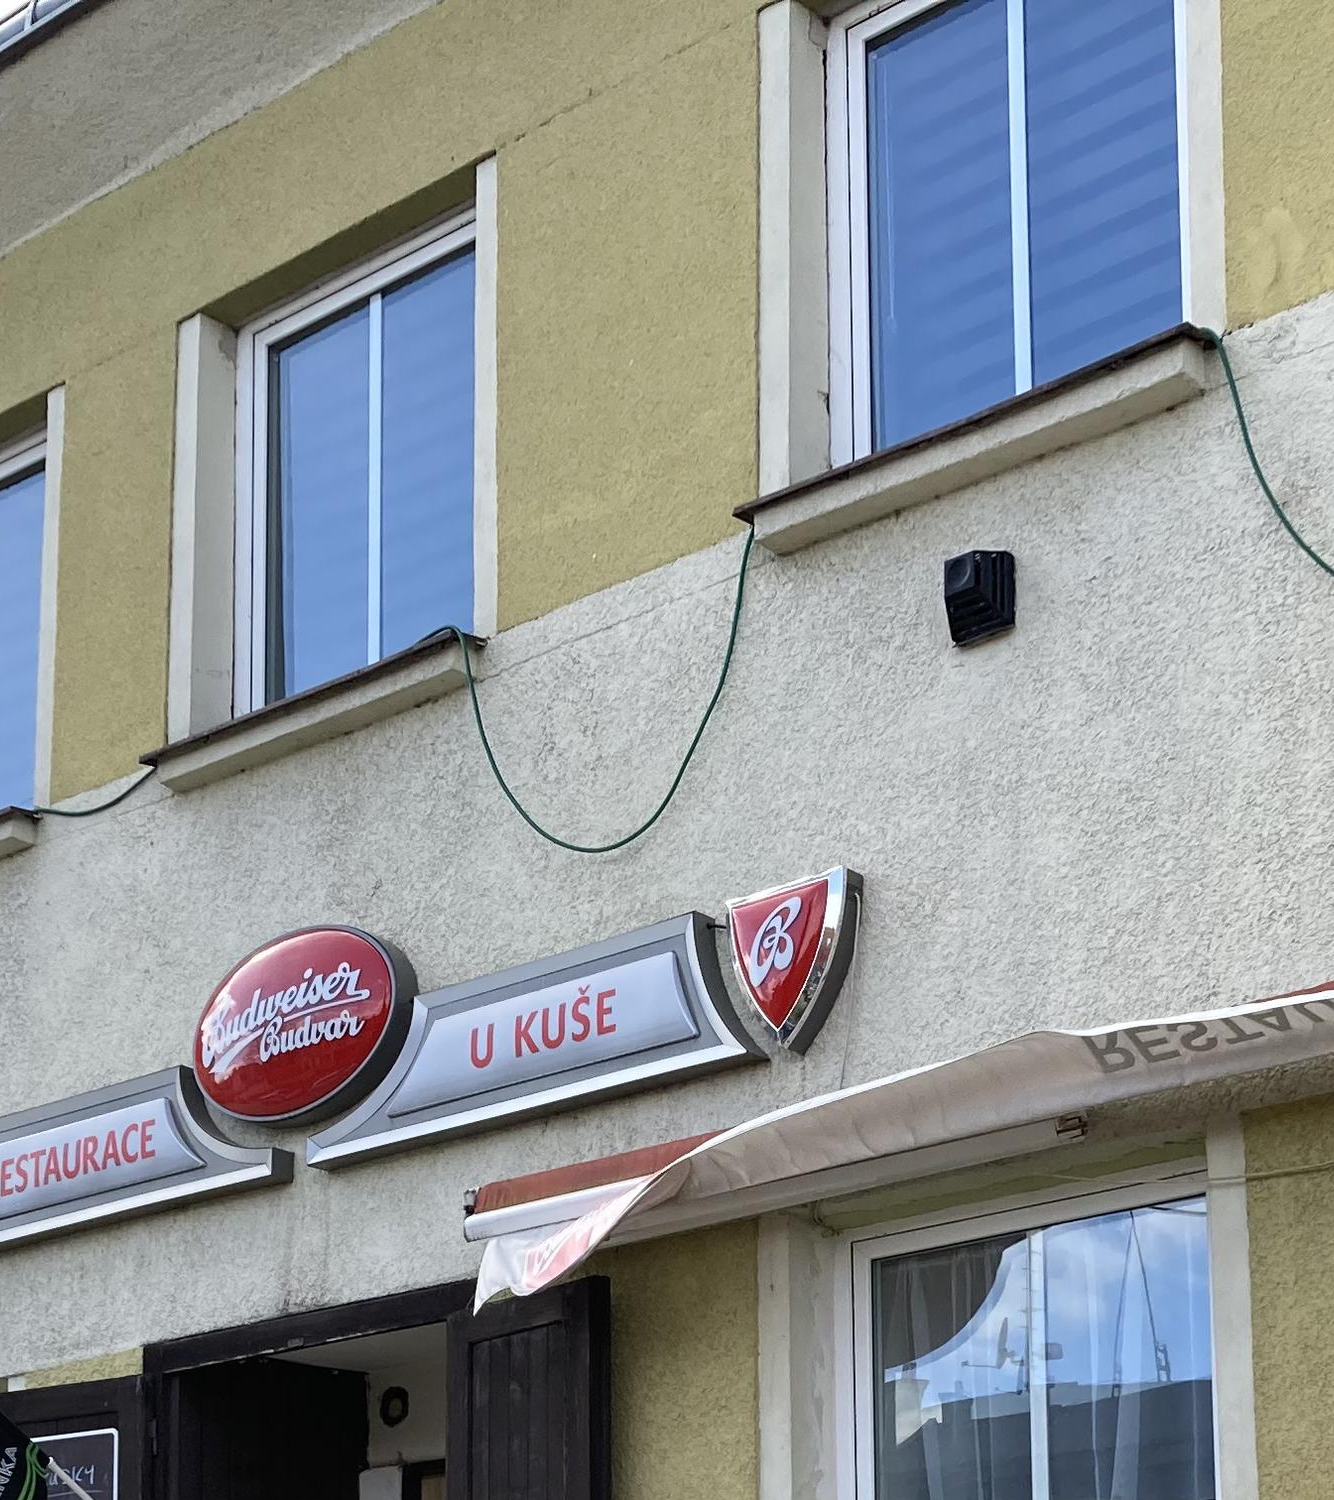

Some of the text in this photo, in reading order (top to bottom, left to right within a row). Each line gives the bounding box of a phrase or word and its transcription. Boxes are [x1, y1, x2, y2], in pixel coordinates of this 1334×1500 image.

[201, 961, 371, 1069] Budweiser
[259, 1009, 365, 1063] Budvar
[470, 984, 617, 1069] U KUŠE
